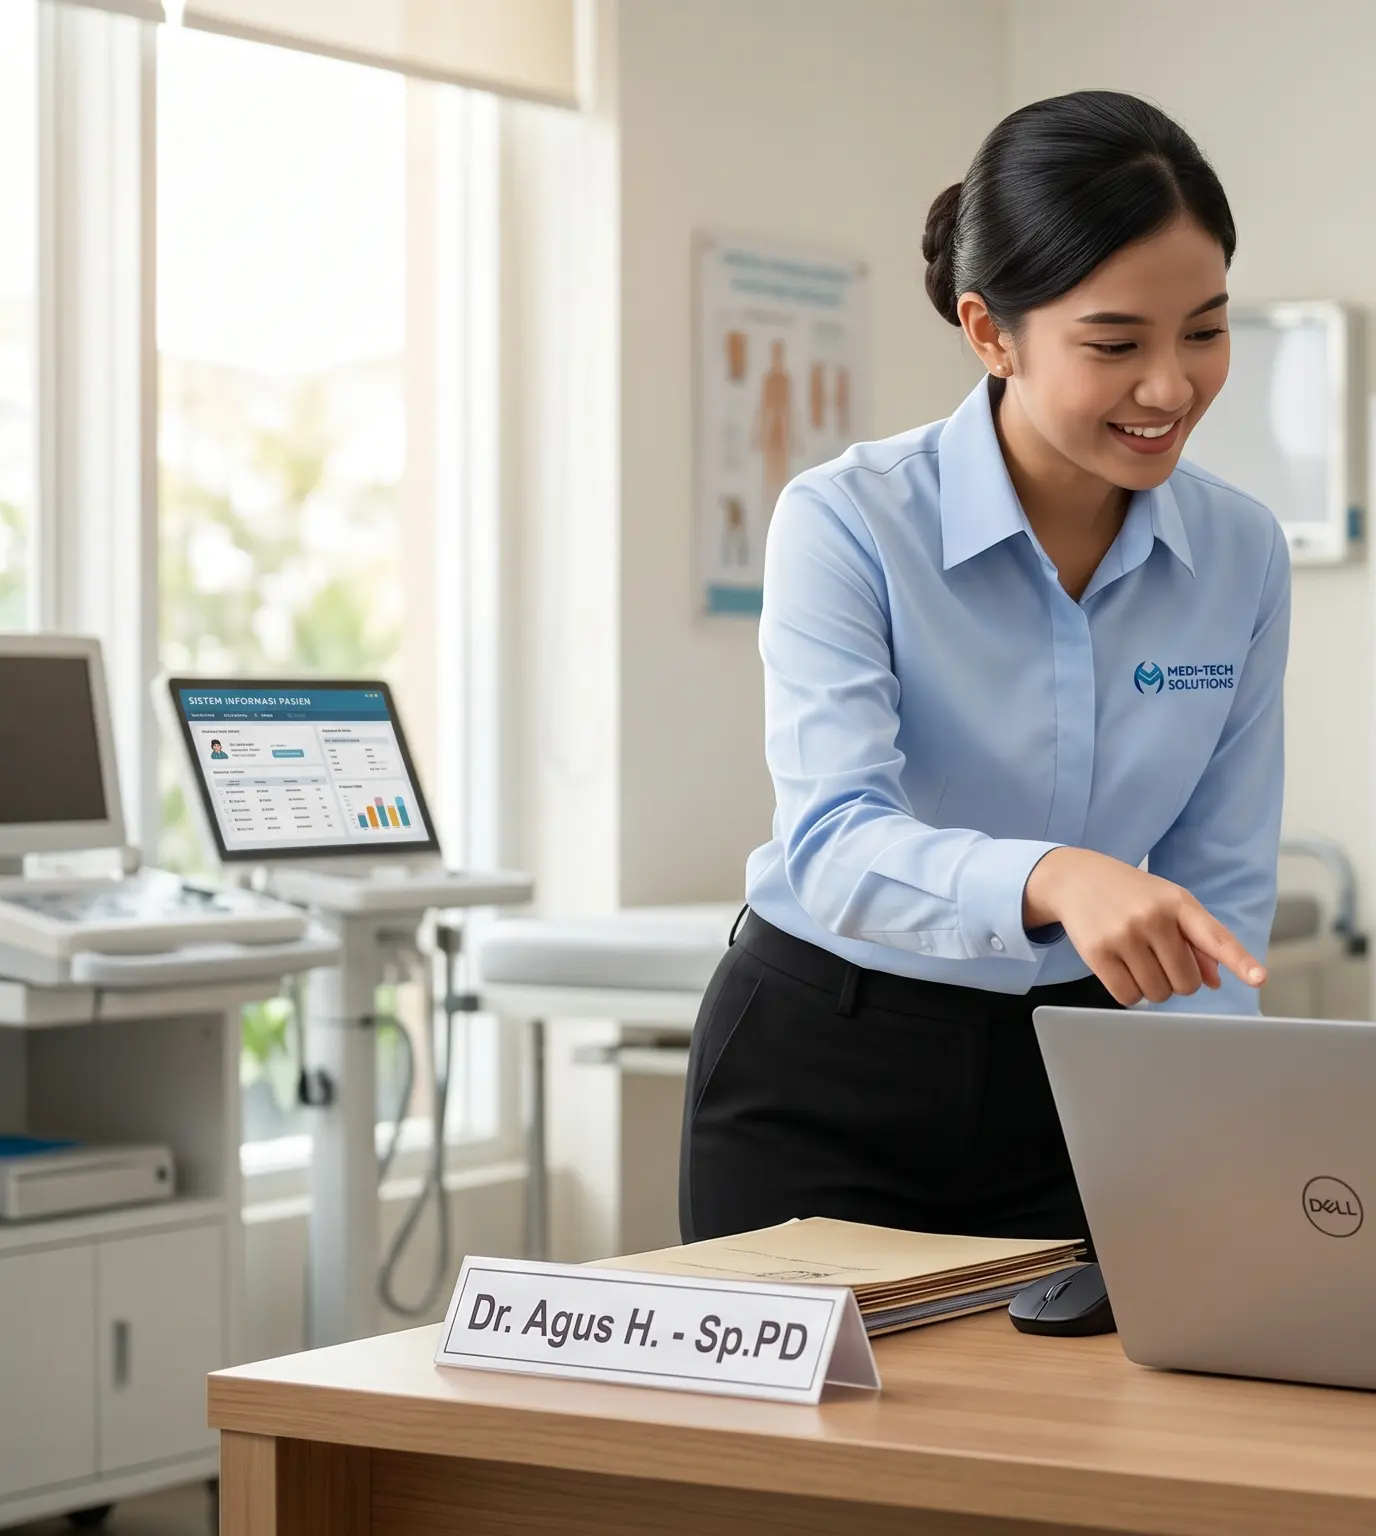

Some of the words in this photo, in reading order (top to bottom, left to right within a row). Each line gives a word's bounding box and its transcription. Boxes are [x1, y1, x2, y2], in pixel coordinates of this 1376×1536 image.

[1167, 664, 1234, 677] MEDI-TECH
[1168, 678, 1234, 691] SOLUTIONS
[188, 696, 223, 705] SISTEM
[278, 697, 312, 706] PASIEN
[1309, 1198, 1357, 1216] DELL
[467, 1292, 512, 1334] Dr.
[522, 1298, 615, 1349] Agus
[623, 1307, 659, 1348] H.
[694, 1313, 809, 1364] Sp.PD
